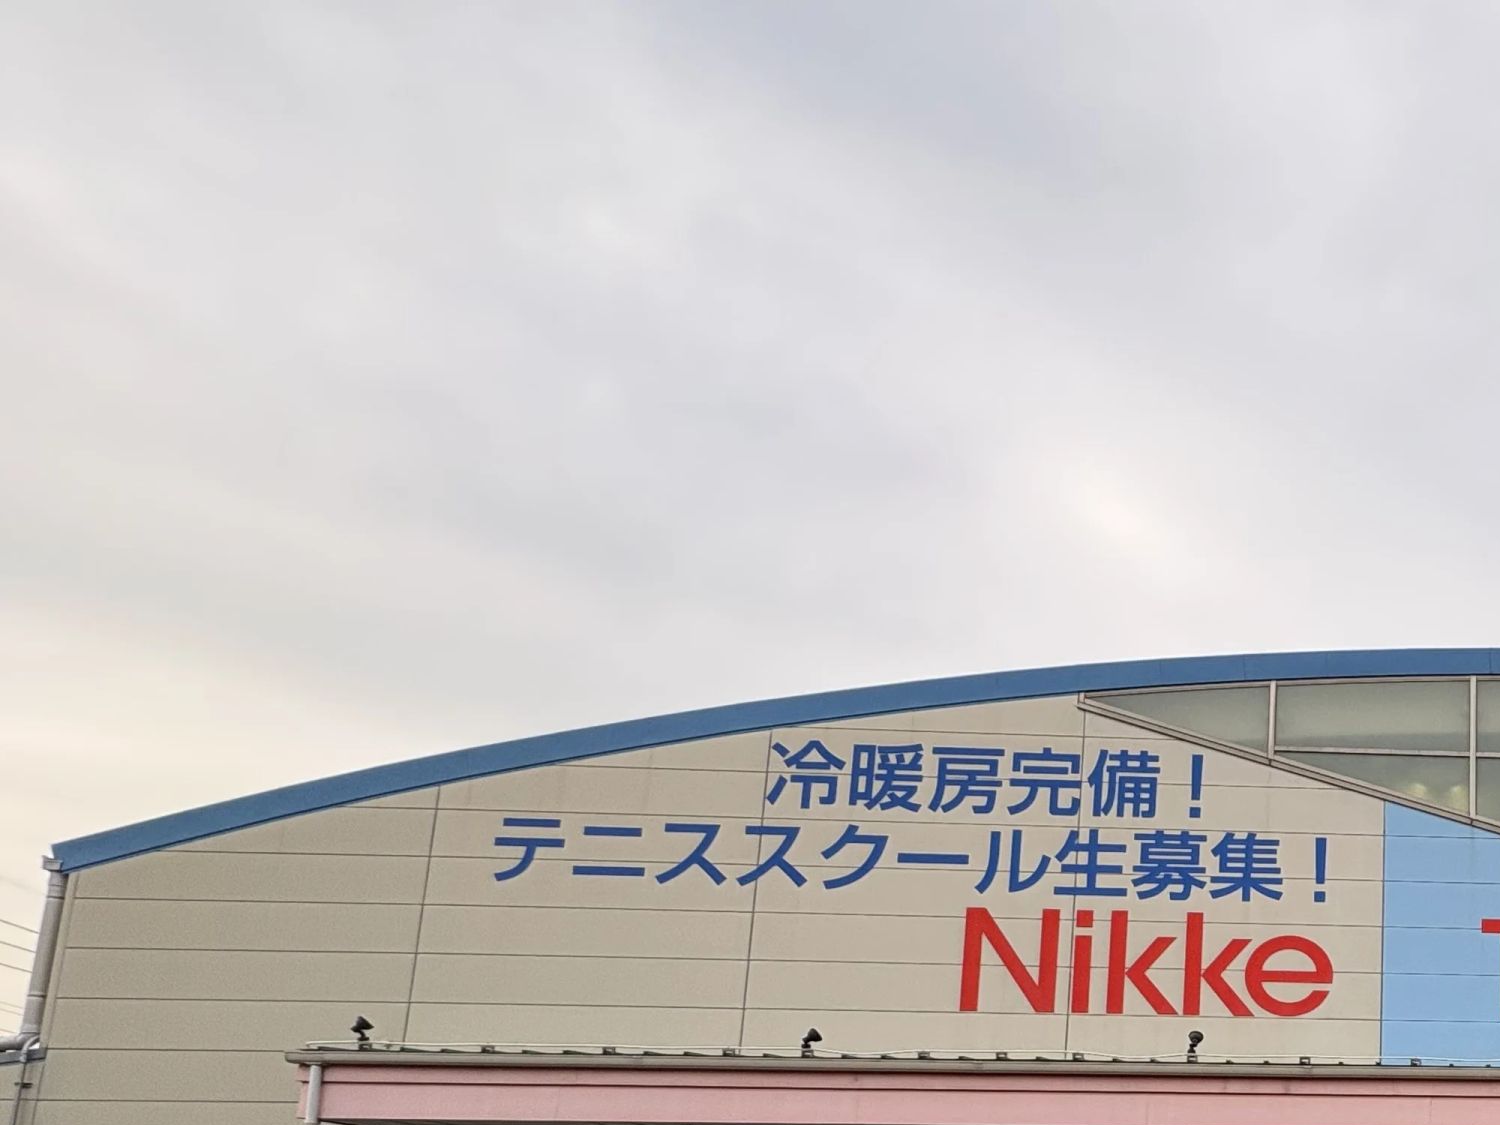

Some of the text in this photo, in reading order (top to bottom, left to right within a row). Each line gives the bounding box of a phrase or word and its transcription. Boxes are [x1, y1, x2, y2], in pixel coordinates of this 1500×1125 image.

[767, 741, 1203, 818] 冷暖房完備！
[493, 817, 1329, 903] テニススクール生募集！
[959, 907, 1334, 1018] Nikke
